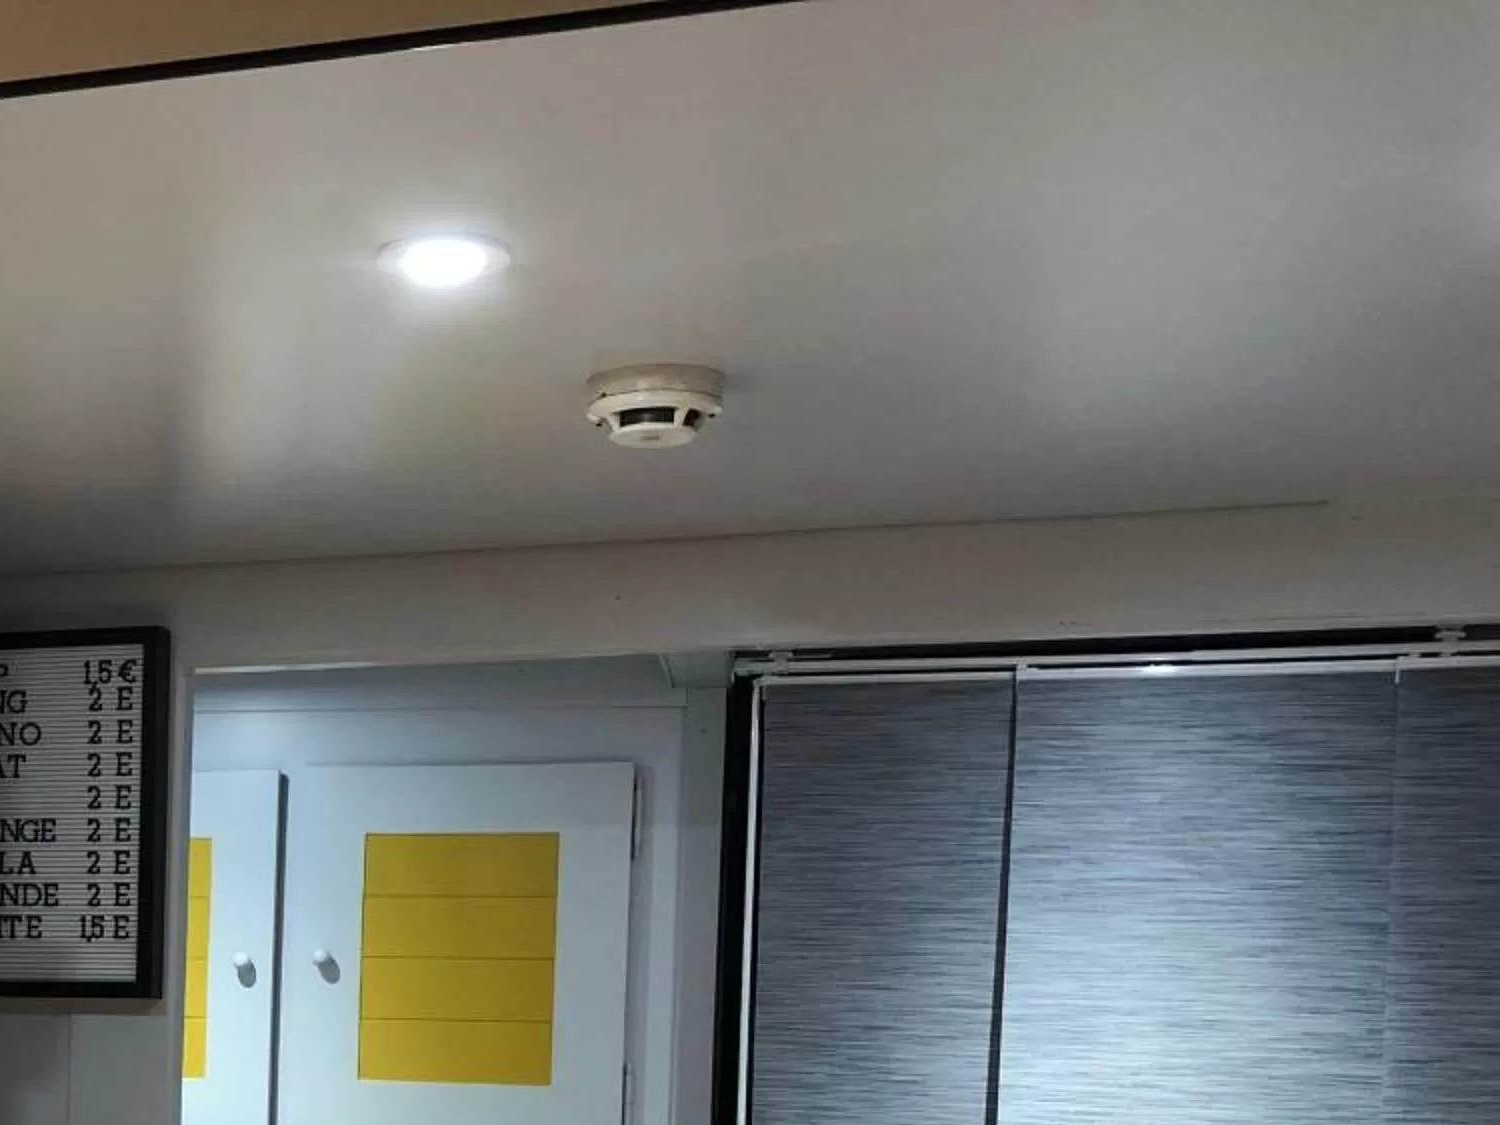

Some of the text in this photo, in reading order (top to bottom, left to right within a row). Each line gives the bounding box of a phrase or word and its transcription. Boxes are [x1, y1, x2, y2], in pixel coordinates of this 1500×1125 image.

[118, 659, 137, 685] €
[88, 687, 103, 712] 2
[116, 686, 133, 711] E
[87, 720, 102, 745] 2
[116, 719, 133, 744] E
[87, 752, 102, 777] 2
[115, 752, 133, 777] E
[87, 785, 102, 810] 2
[114, 784, 132, 809] E
[86, 817, 101, 842] 2
[113, 817, 131, 842] E
[86, 850, 101, 875] 2
[113, 850, 131, 875] E
[86, 882, 101, 907] 2
[113, 882, 131, 907] E
[113, 914, 130, 939] E
